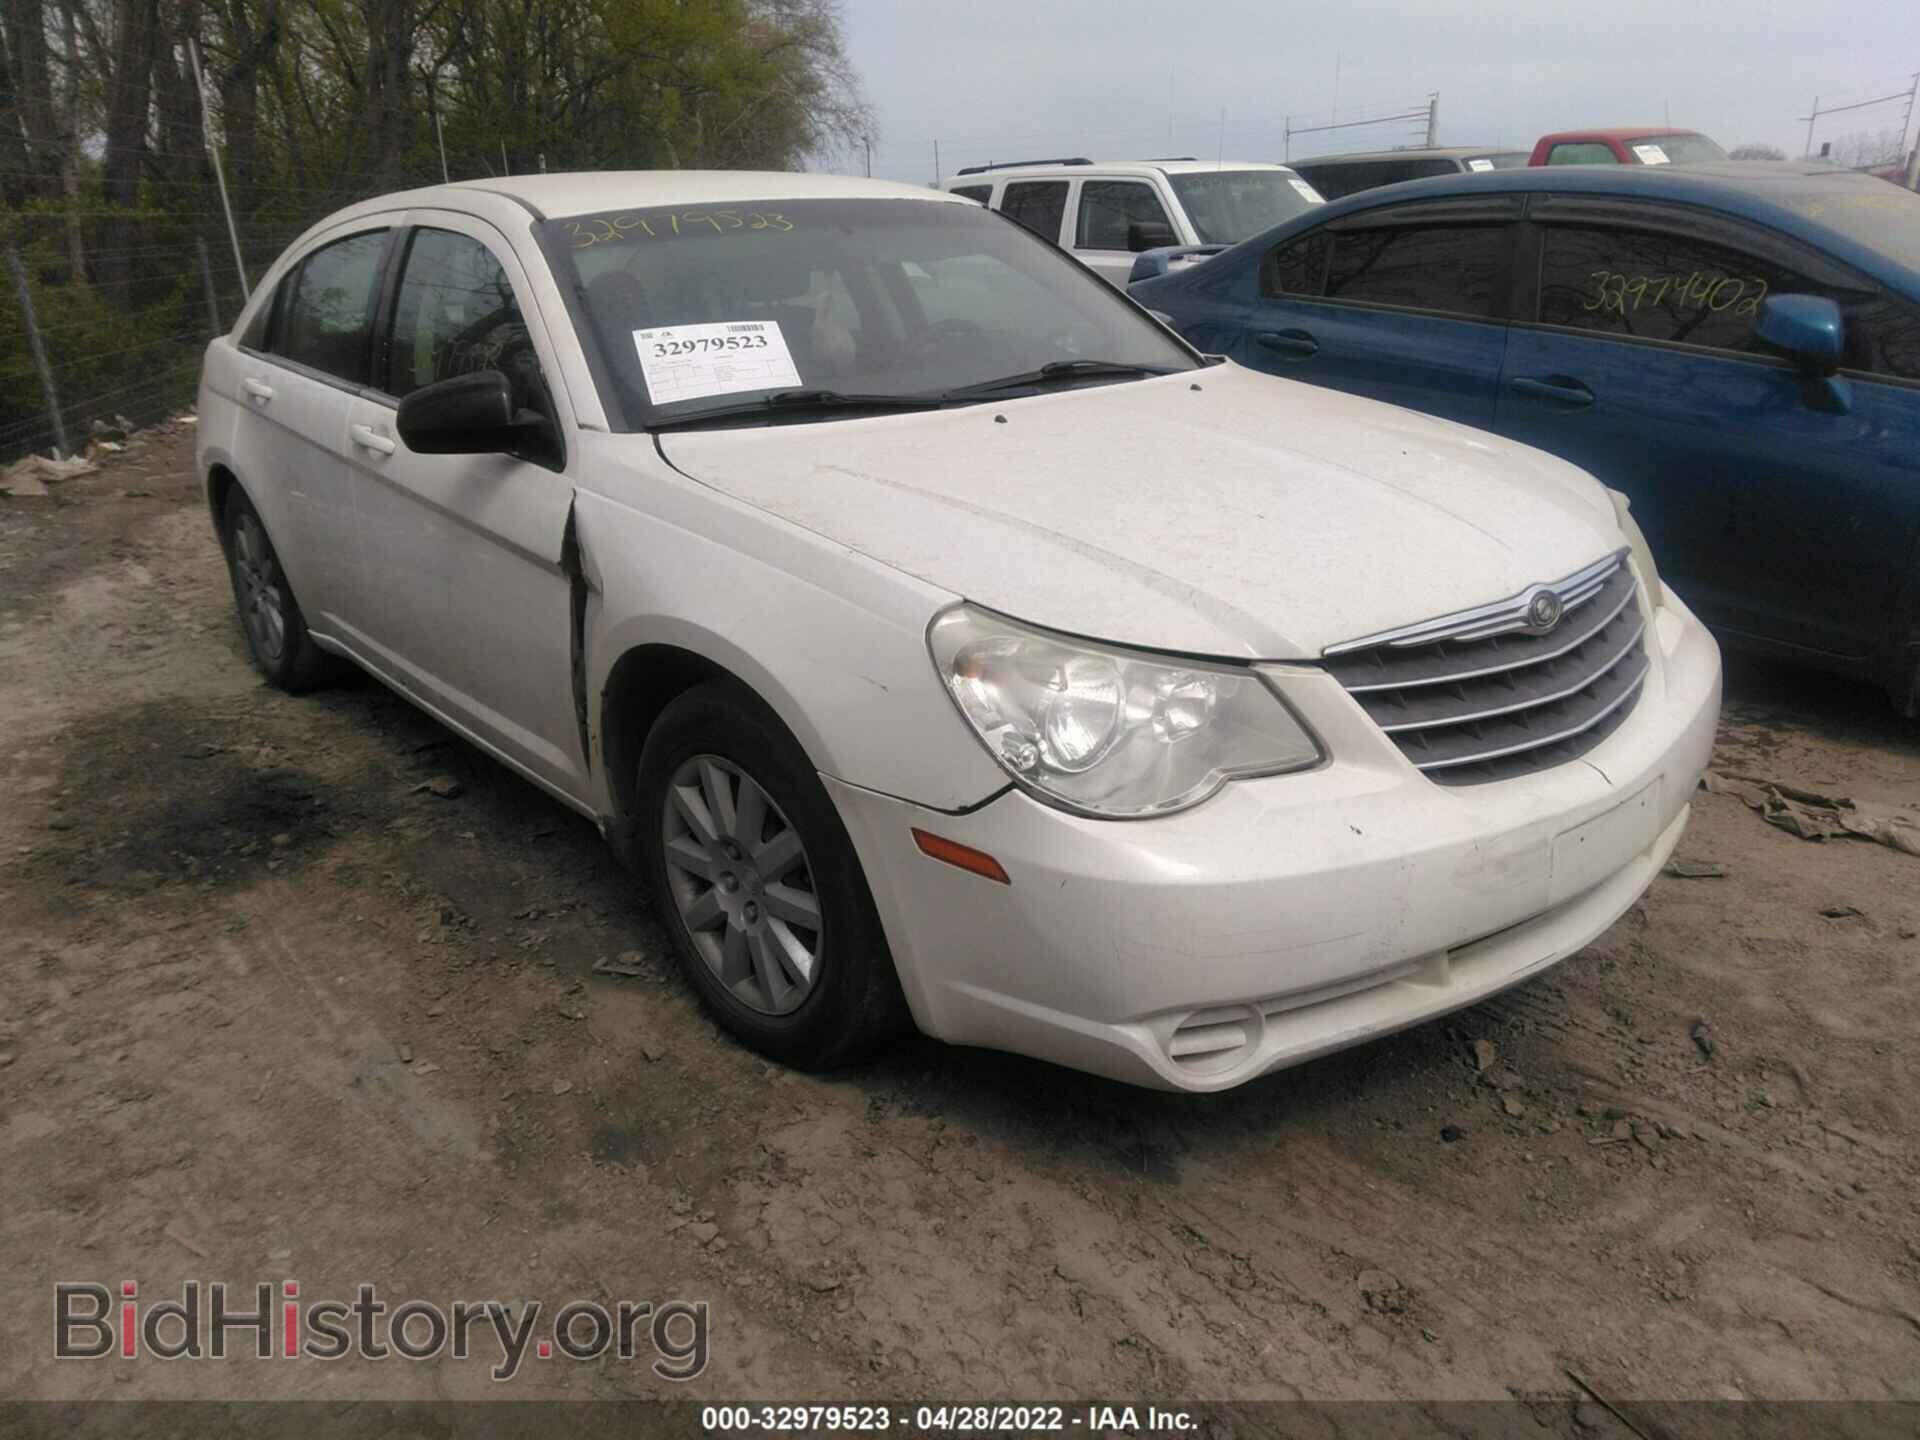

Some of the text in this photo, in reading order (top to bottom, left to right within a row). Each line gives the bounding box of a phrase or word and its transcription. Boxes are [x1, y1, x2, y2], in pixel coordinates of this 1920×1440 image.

[565, 210, 795, 248] 32979523
[1583, 271, 1768, 315] 32974402
[653, 335, 768, 358] 32979523
